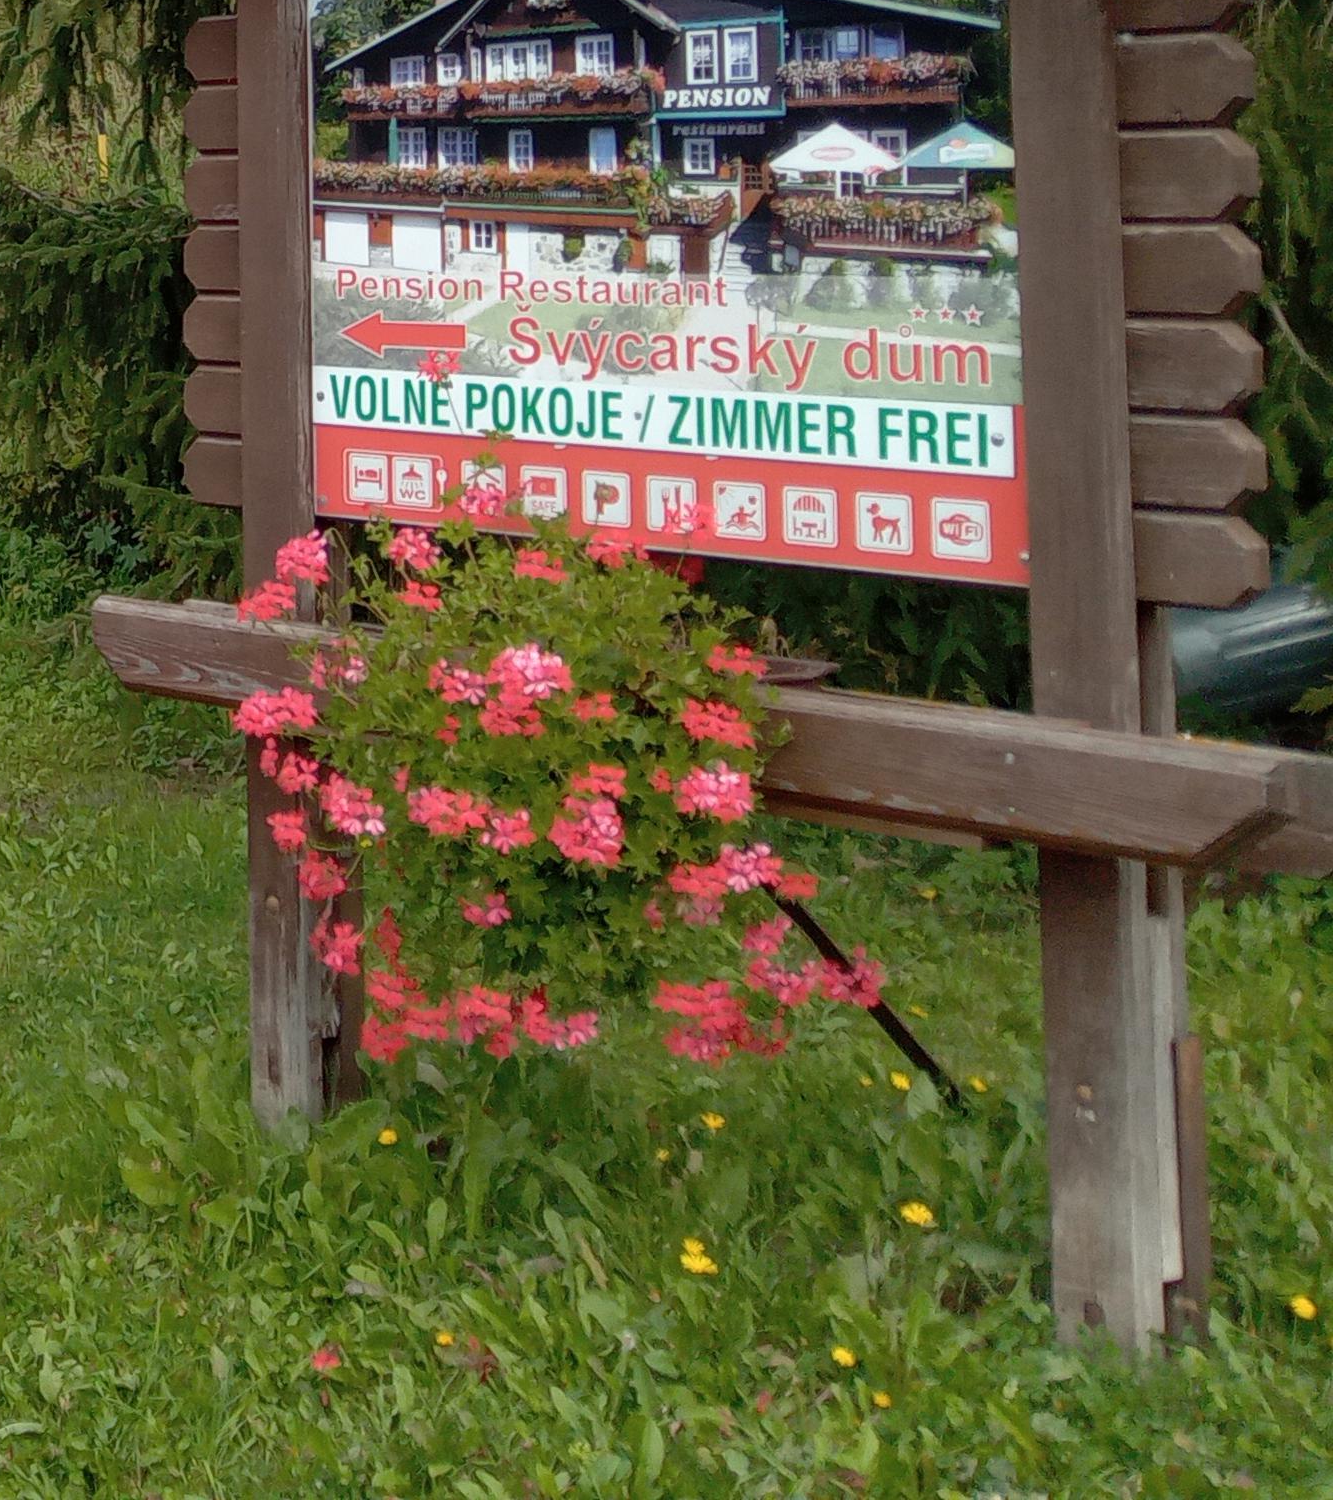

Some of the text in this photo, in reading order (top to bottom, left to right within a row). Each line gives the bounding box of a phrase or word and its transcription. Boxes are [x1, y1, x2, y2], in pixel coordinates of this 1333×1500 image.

[662, 86, 772, 108] PENSION
[673, 122, 766, 137] restaurant
[336, 268, 728, 307] Pension Restaurant
[508, 303, 992, 392] Švýcarský dům
[465, 382, 623, 442] POKOJE
[638, 393, 656, 444] /
[667, 394, 858, 458] ZIMMER
[877, 405, 989, 468] FREI
[399, 488, 426, 501] WC
